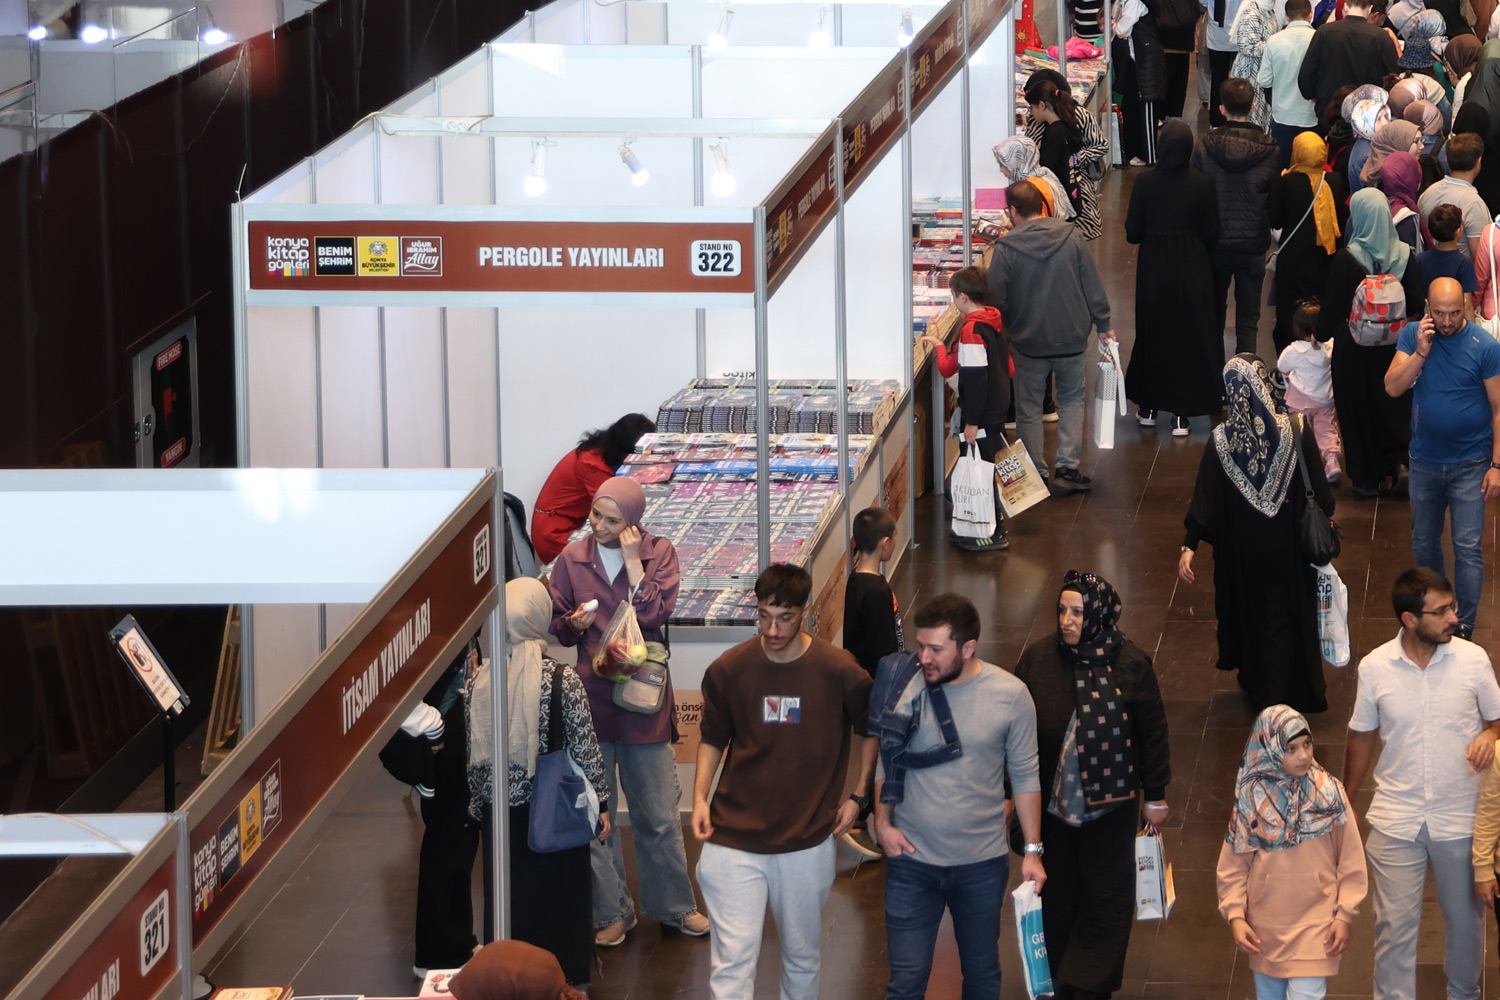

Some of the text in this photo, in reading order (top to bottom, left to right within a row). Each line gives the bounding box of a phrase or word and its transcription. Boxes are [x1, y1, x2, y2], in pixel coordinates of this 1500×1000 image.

[267, 236, 310, 252] konya
[267, 248, 310, 260] kitap
[318, 246, 353, 256] BENİM
[699, 243, 733, 251] STAND NO
[267, 259, 310, 271] günleri
[318, 257, 353, 267] ŞEHRİM
[479, 246, 664, 267] PERGOLE YAYINLARI
[698, 252, 734, 272] 322
[165, 441, 183, 463] YANGIN
[998, 460, 1022, 476] kitap
[475, 542, 488, 577] 321
[342, 597, 431, 736] İTİSAM YAYINLARI
[220, 823, 239, 855] BENİM
[194, 834, 217, 871] konya
[221, 841, 239, 873] ŞEHRİM
[194, 853, 217, 892] kitap
[144, 913, 165, 967] 321
